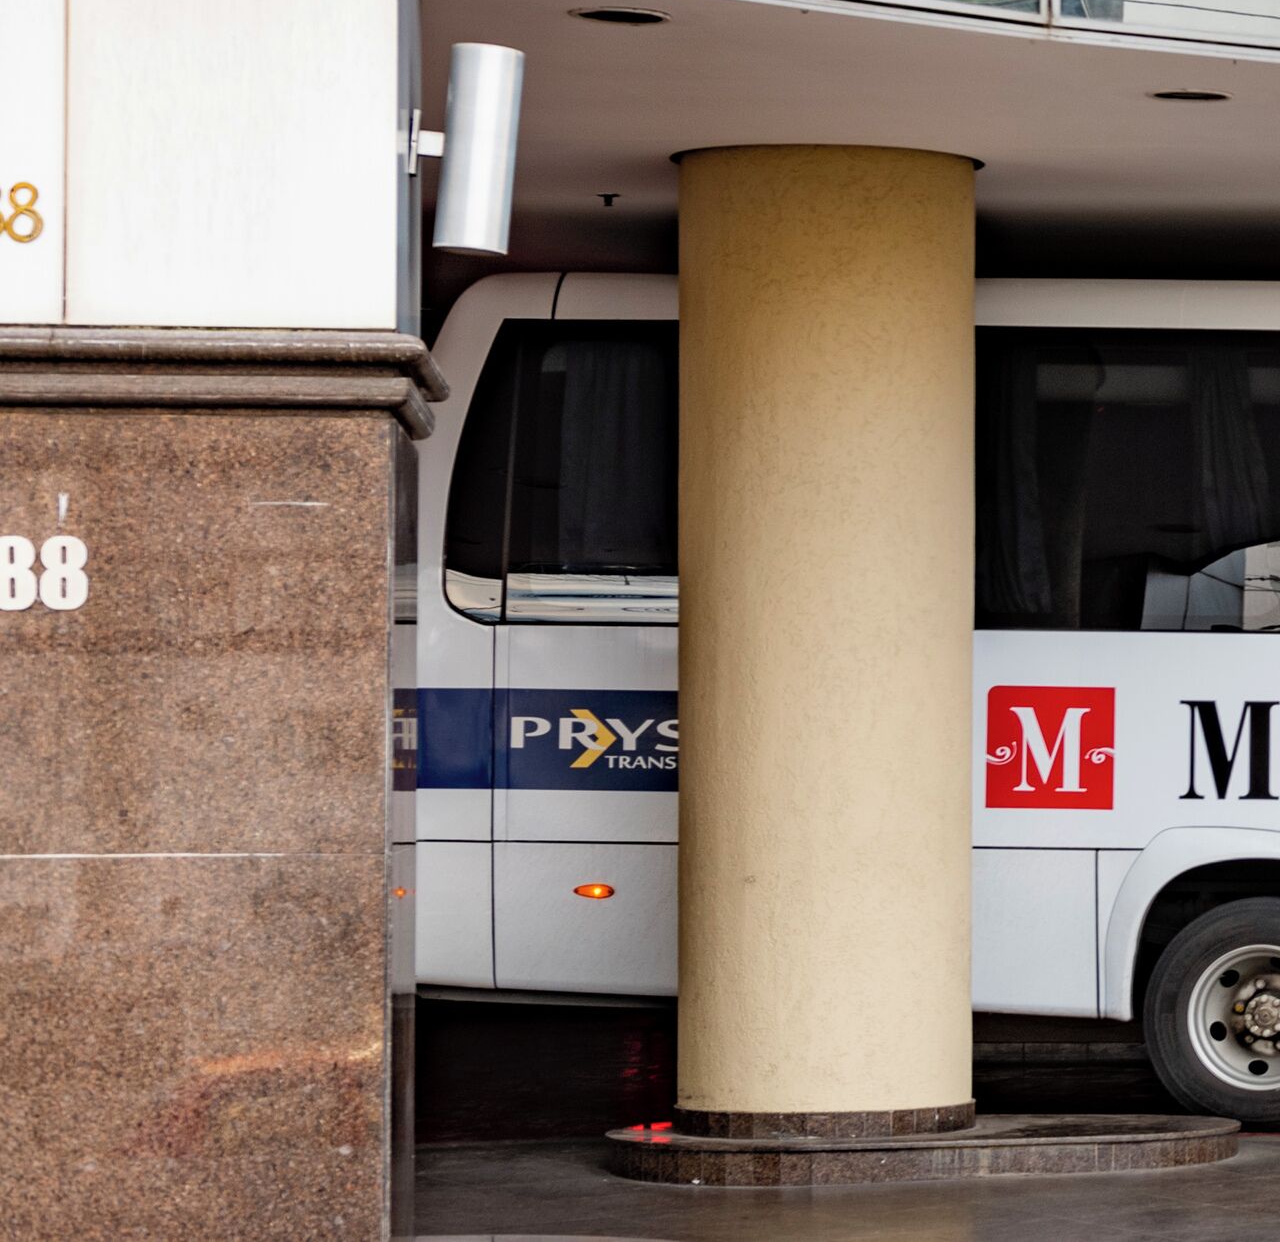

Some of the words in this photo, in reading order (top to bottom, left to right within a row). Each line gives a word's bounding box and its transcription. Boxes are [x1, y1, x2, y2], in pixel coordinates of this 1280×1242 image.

[0, 182, 44, 244] 8
[604, 755, 677, 770] TRANS
[1009, 706, 1091, 792] M
